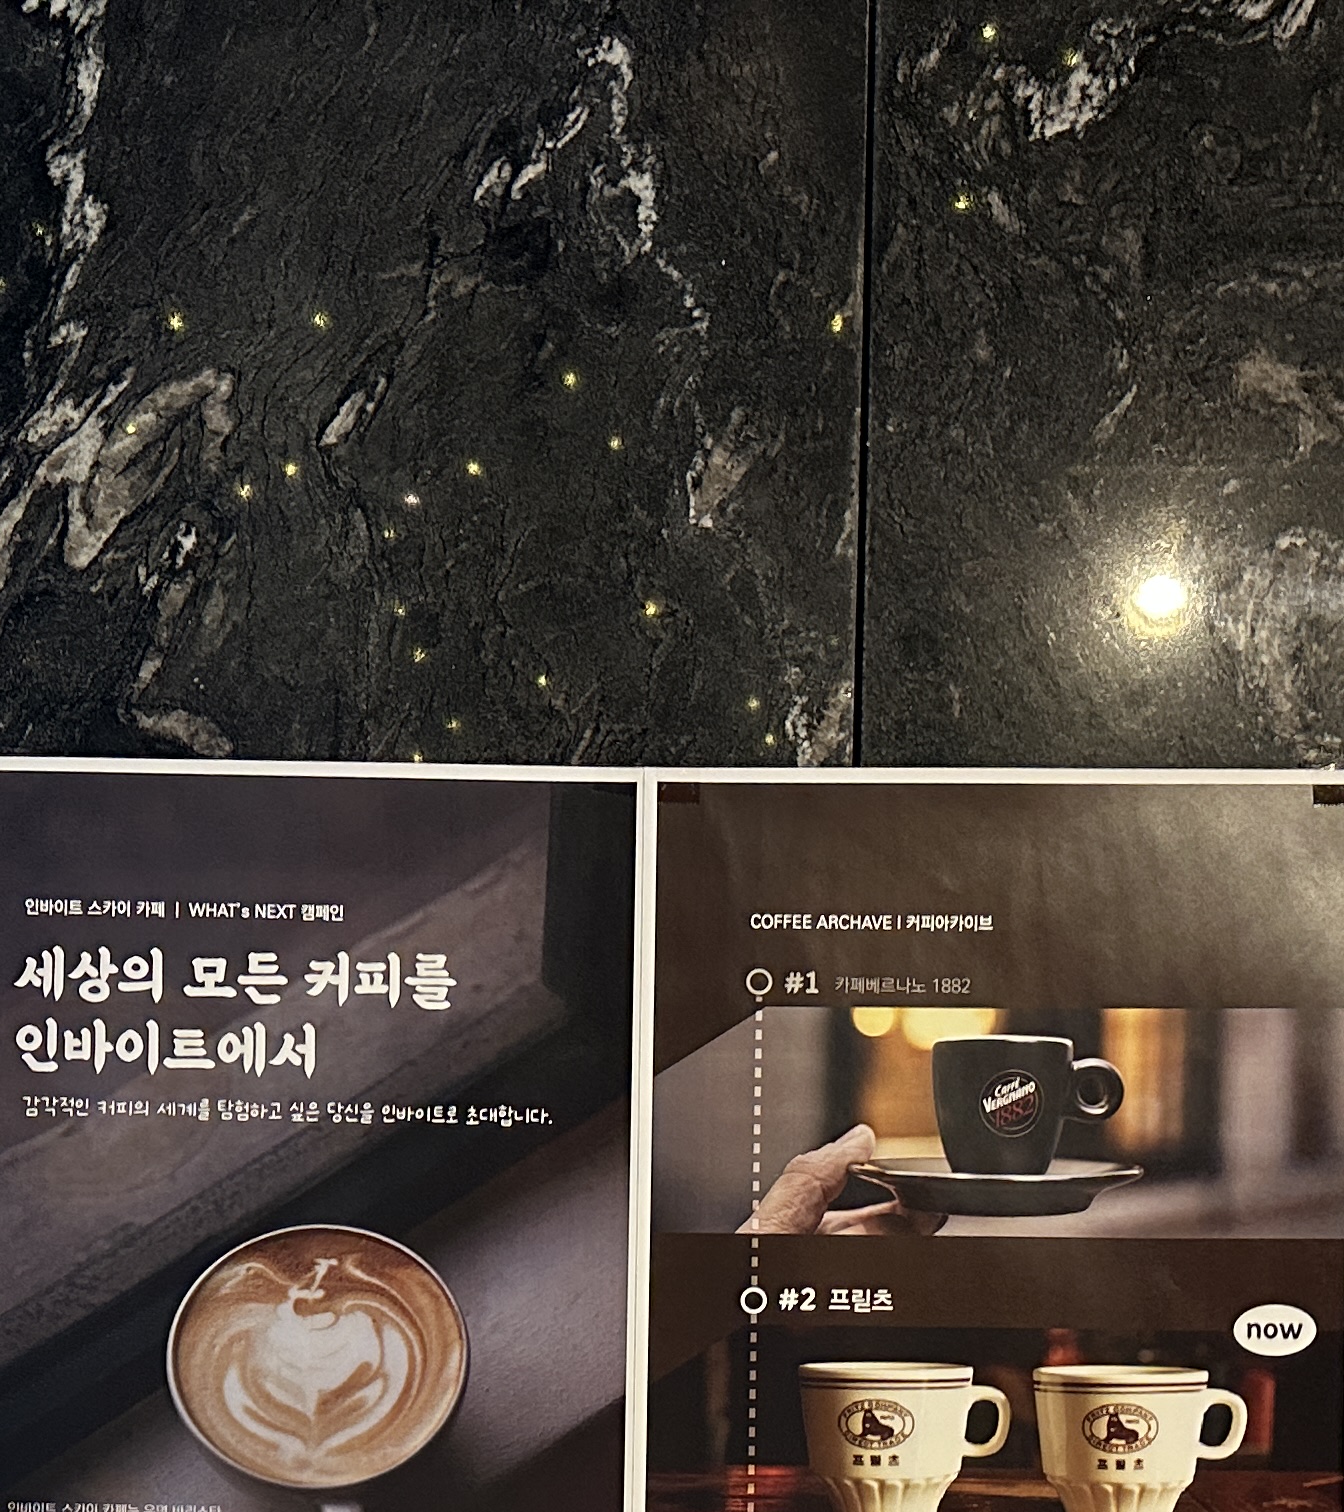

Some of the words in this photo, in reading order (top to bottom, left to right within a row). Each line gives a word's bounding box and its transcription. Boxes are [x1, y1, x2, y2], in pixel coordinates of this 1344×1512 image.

[24, 898, 83, 916] 인바이트
[87, 899, 132, 918] 스카이
[136, 901, 165, 918] 카페
[188, 902, 250, 919] WHAT's
[255, 904, 296, 919] NEXT
[301, 903, 344, 922] 캠페인
[750, 913, 812, 930] COFFEE
[815, 914, 892, 931] ARCHAVE
[906, 914, 994, 932] 커피아카이브
[14, 945, 164, 1004] 세상의
[183, 951, 288, 1005] 모든
[303, 951, 457, 1010] 커피를
[784, 971, 819, 994] #1
[834, 976, 927, 994] 카페베르나노
[932, 977, 971, 994] 1882
[15, 1017, 316, 1079] 인바이트에서
[22, 1095, 90, 1117] 감각적인
[97, 1100, 149, 1117] 커피의
[156, 1097, 210, 1122] 세계를
[217, 1099, 282, 1122] 탐험하고
[289, 1101, 320, 1122] 싶은
[327, 1101, 375, 1125] 당신을
[381, 1104, 458, 1124] 인바이트로
[466, 1104, 553, 1127] 초대합니다.
[778, 1287, 817, 1312] #2
[828, 1288, 894, 1313] 프릳츠
[1247, 1322, 1303, 1340] now
